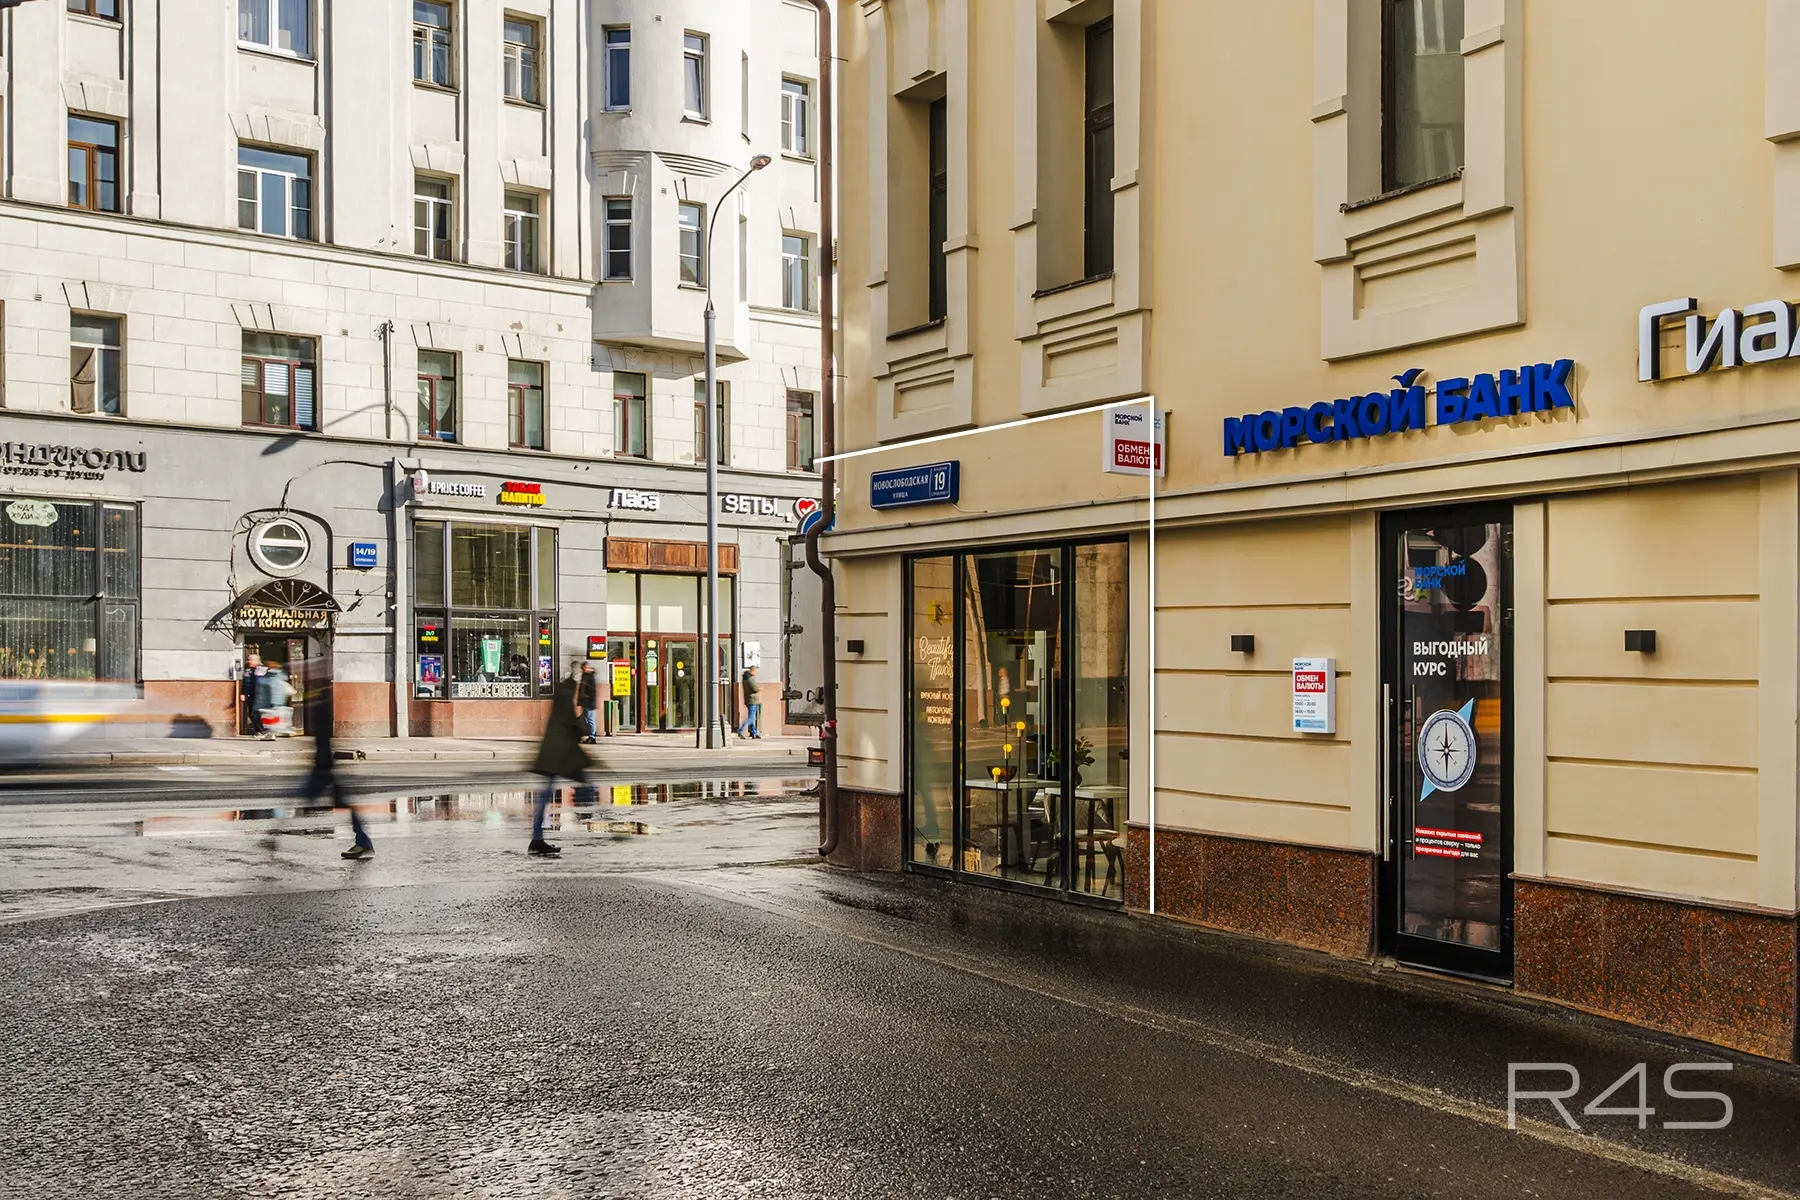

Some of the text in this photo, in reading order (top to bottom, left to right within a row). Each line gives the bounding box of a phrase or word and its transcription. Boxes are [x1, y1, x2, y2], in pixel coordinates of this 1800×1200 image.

[1637, 297, 1800, 383] Гиа
[1223, 357, 1575, 457] МОРСКОЙ БАНК
[1114, 413, 1143, 422] МОРСКОЙ
[1117, 443, 1150, 455] ОБМЕН
[873, 474, 929, 491] НОВОСЛОБОДСКАЯ
[934, 471, 946, 491] 19
[437, 481, 458, 496] PRICE
[459, 483, 487, 498] COFFEE
[892, 491, 909, 499] УЛИЦА
[501, 491, 546, 505] НАПИТКИ
[355, 547, 376, 557] 14/19
[1413, 560, 1466, 577] МОРСКОЙ
[1413, 577, 1442, 589] БАНК
[239, 607, 328, 620] НОТАРИАЛЬНАЯ
[258, 618, 308, 629] КОНТОРА
[591, 643, 605, 651] 24/7
[1413, 637, 1488, 659] ВЫГОДНЫЙ
[1413, 662, 1447, 676] КУРС
[1296, 674, 1319, 682] ОБМЕН
[492, 684, 526, 698] COFFEE
[1296, 682, 1324, 690] ВАЛЮТЫ
